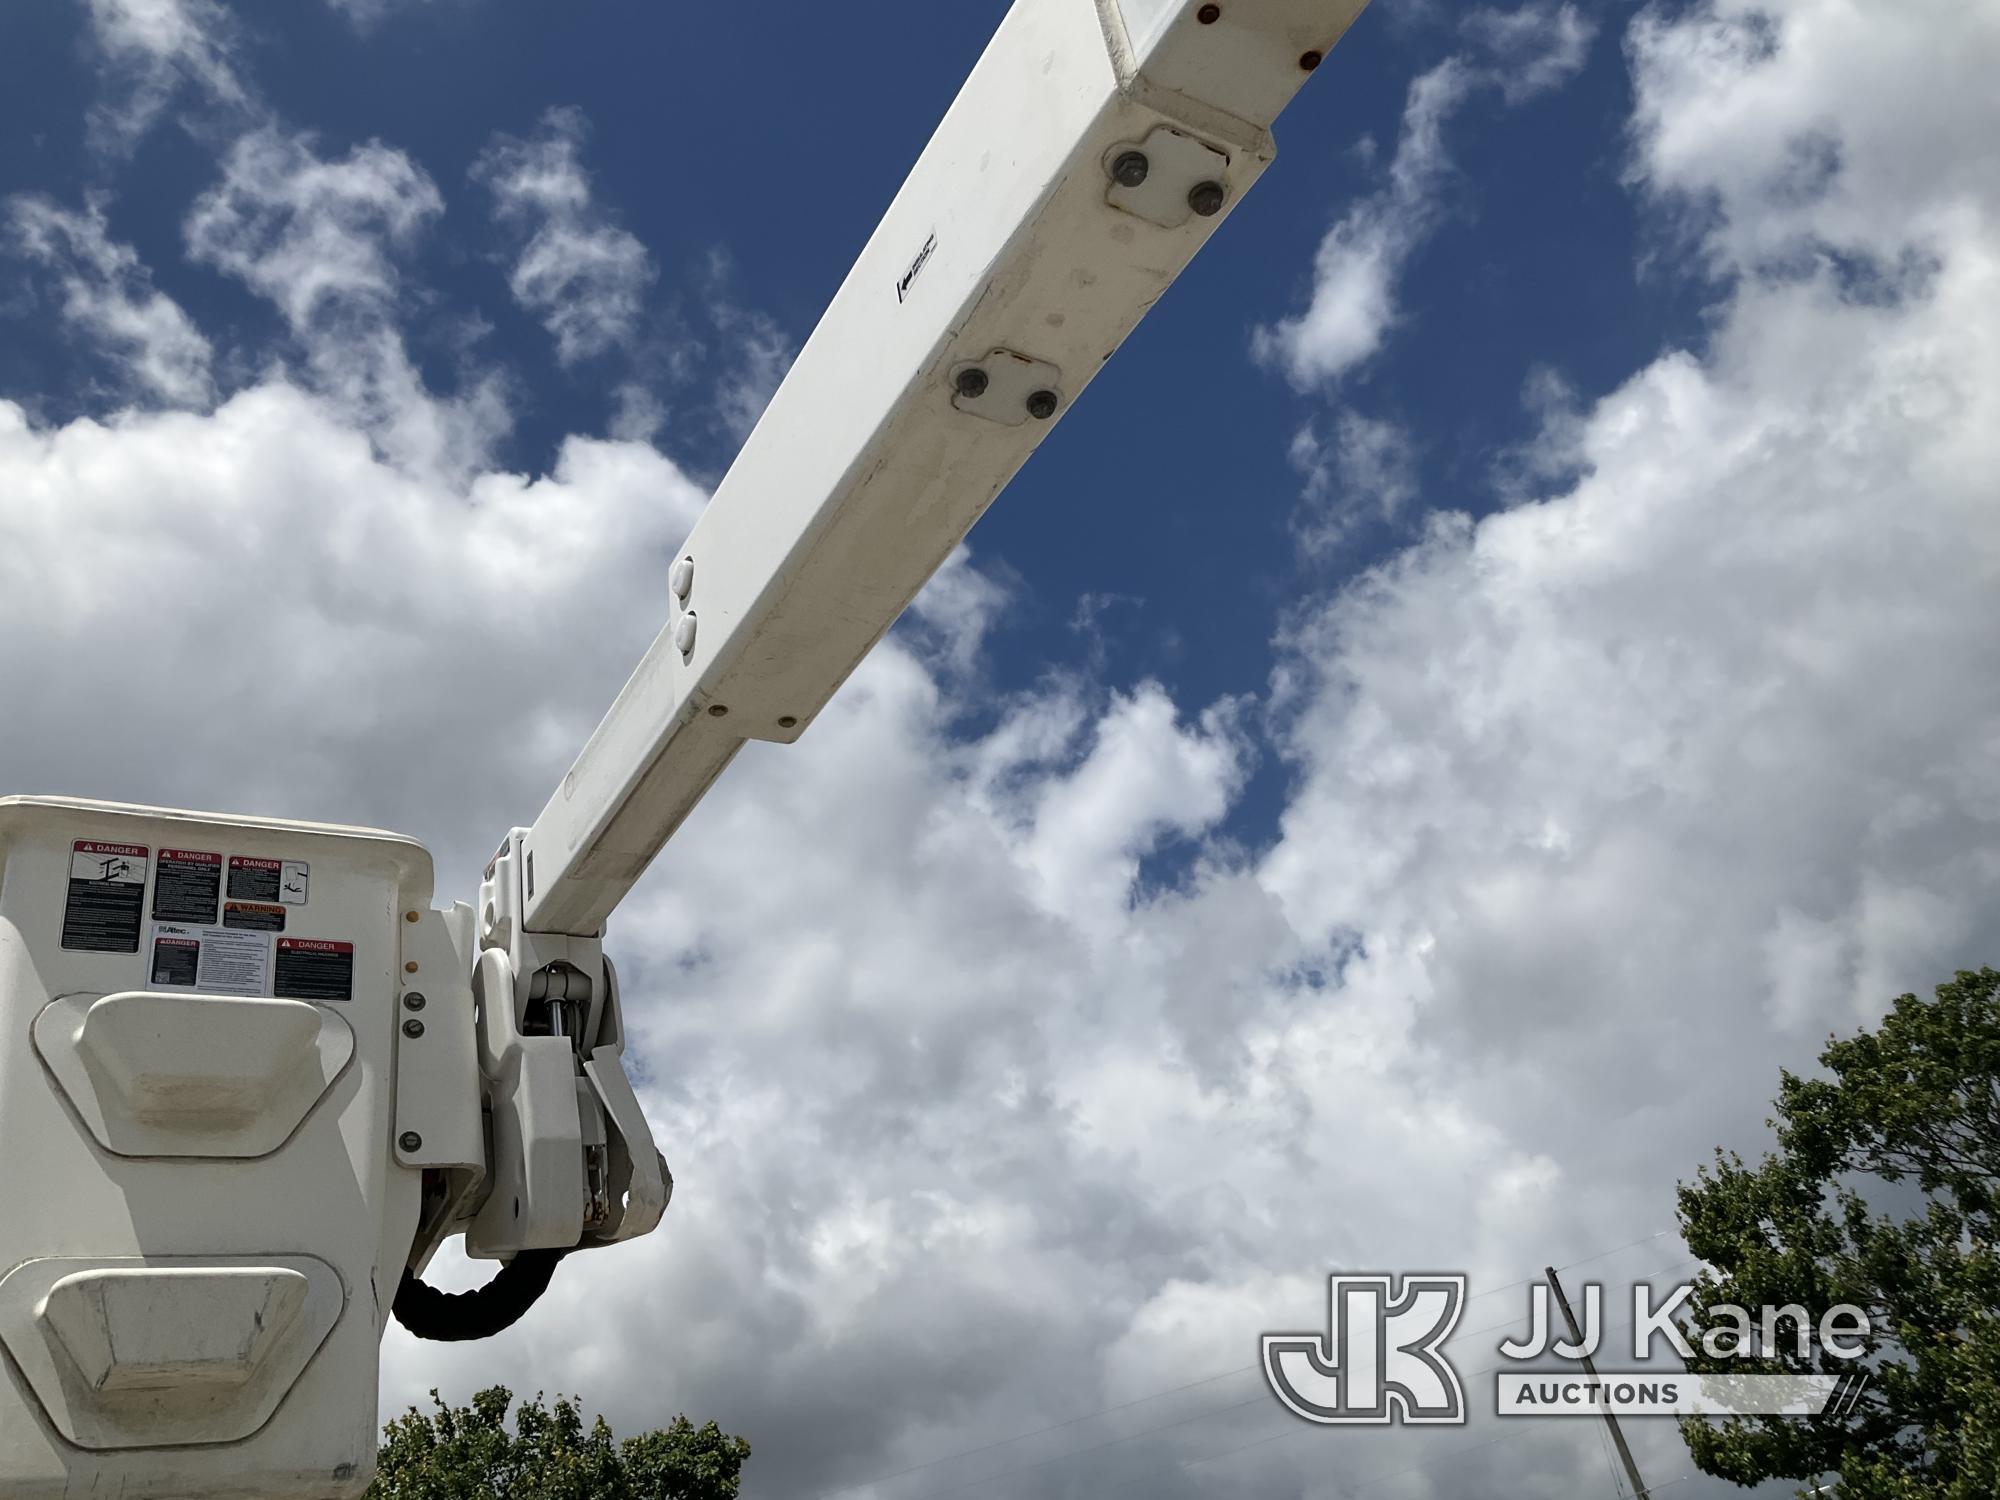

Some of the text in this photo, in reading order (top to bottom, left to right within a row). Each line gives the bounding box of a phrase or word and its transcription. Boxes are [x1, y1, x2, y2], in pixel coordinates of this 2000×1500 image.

[97, 844, 138, 855] DANGER
[177, 851, 213, 861] DANGER
[243, 859, 280, 869] DANGER
[240, 904, 282, 913] WARNING
[165, 939, 197, 947] DANGER
[298, 941, 335, 950] DANGER
